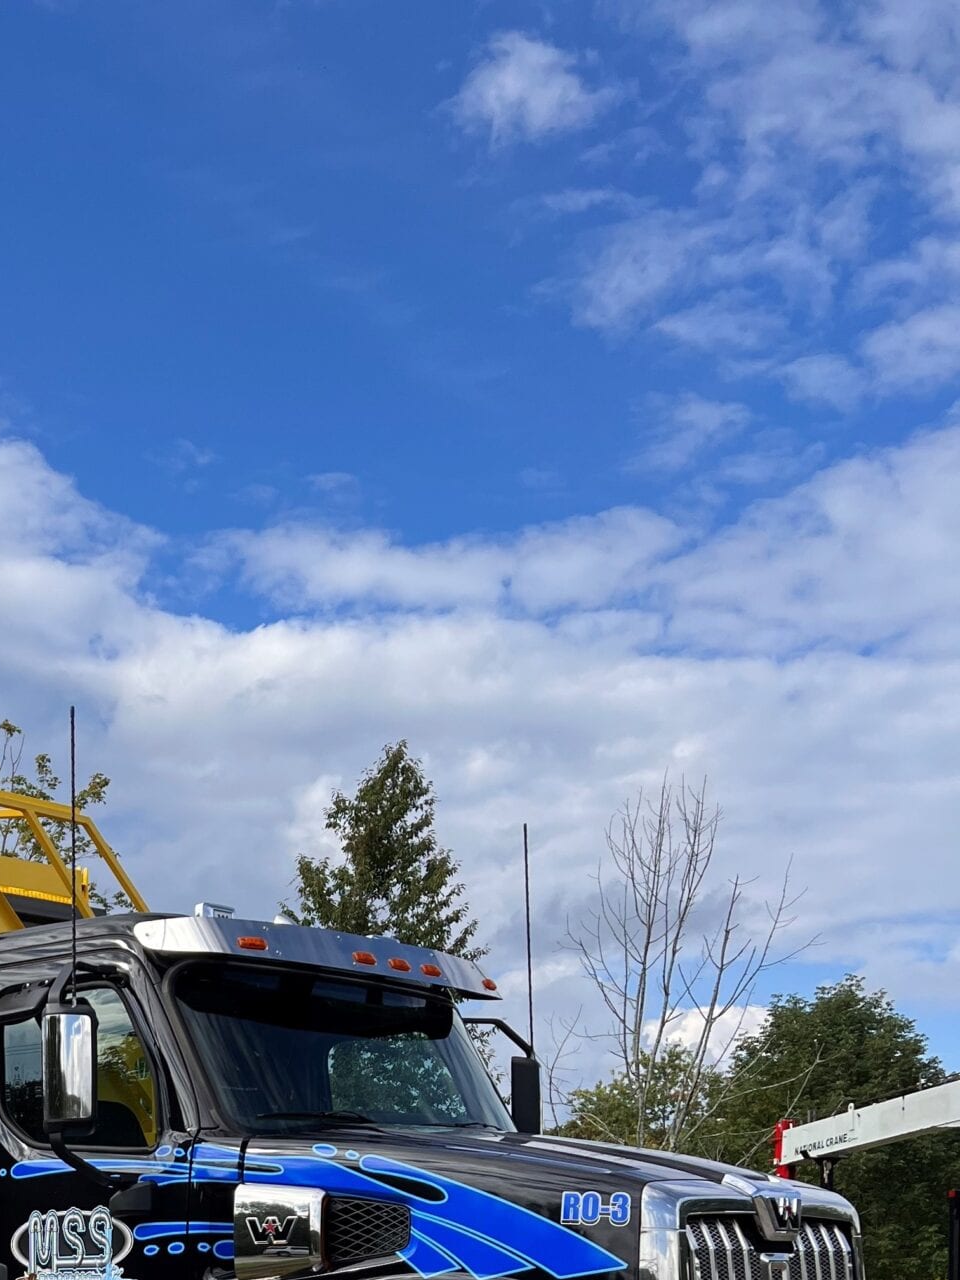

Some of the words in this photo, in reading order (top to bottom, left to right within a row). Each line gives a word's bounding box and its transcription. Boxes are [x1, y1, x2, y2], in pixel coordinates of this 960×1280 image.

[826, 1133, 848, 1148] CRANE
[561, 1191, 631, 1226] RO-3
[28, 1205, 113, 1273] MSS
